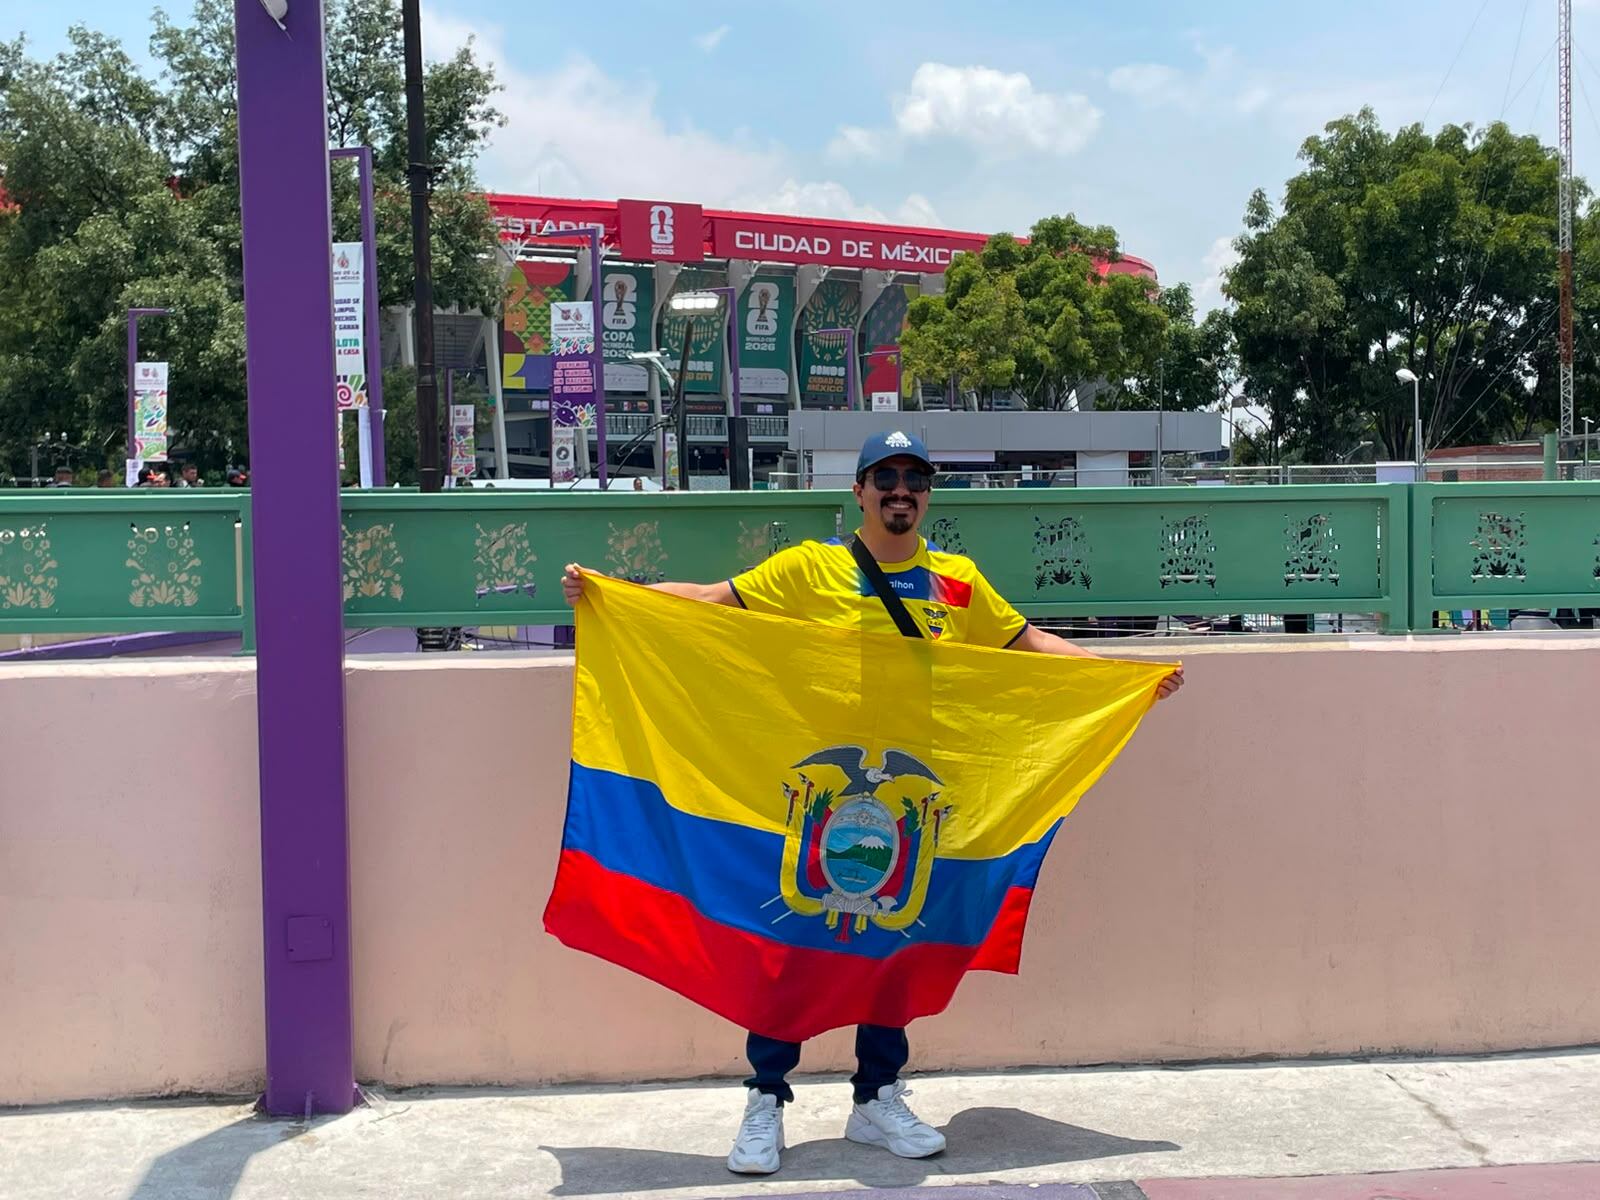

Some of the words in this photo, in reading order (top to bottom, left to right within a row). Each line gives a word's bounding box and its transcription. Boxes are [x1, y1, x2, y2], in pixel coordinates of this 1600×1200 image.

[735, 231, 830, 255] CIUDAD
[842, 240, 873, 259] DE
[755, 323, 769, 331] FIFA
[602, 331, 635, 342] COPA
[337, 338, 360, 347] LOTA
[745, 342, 775, 352] 2026
